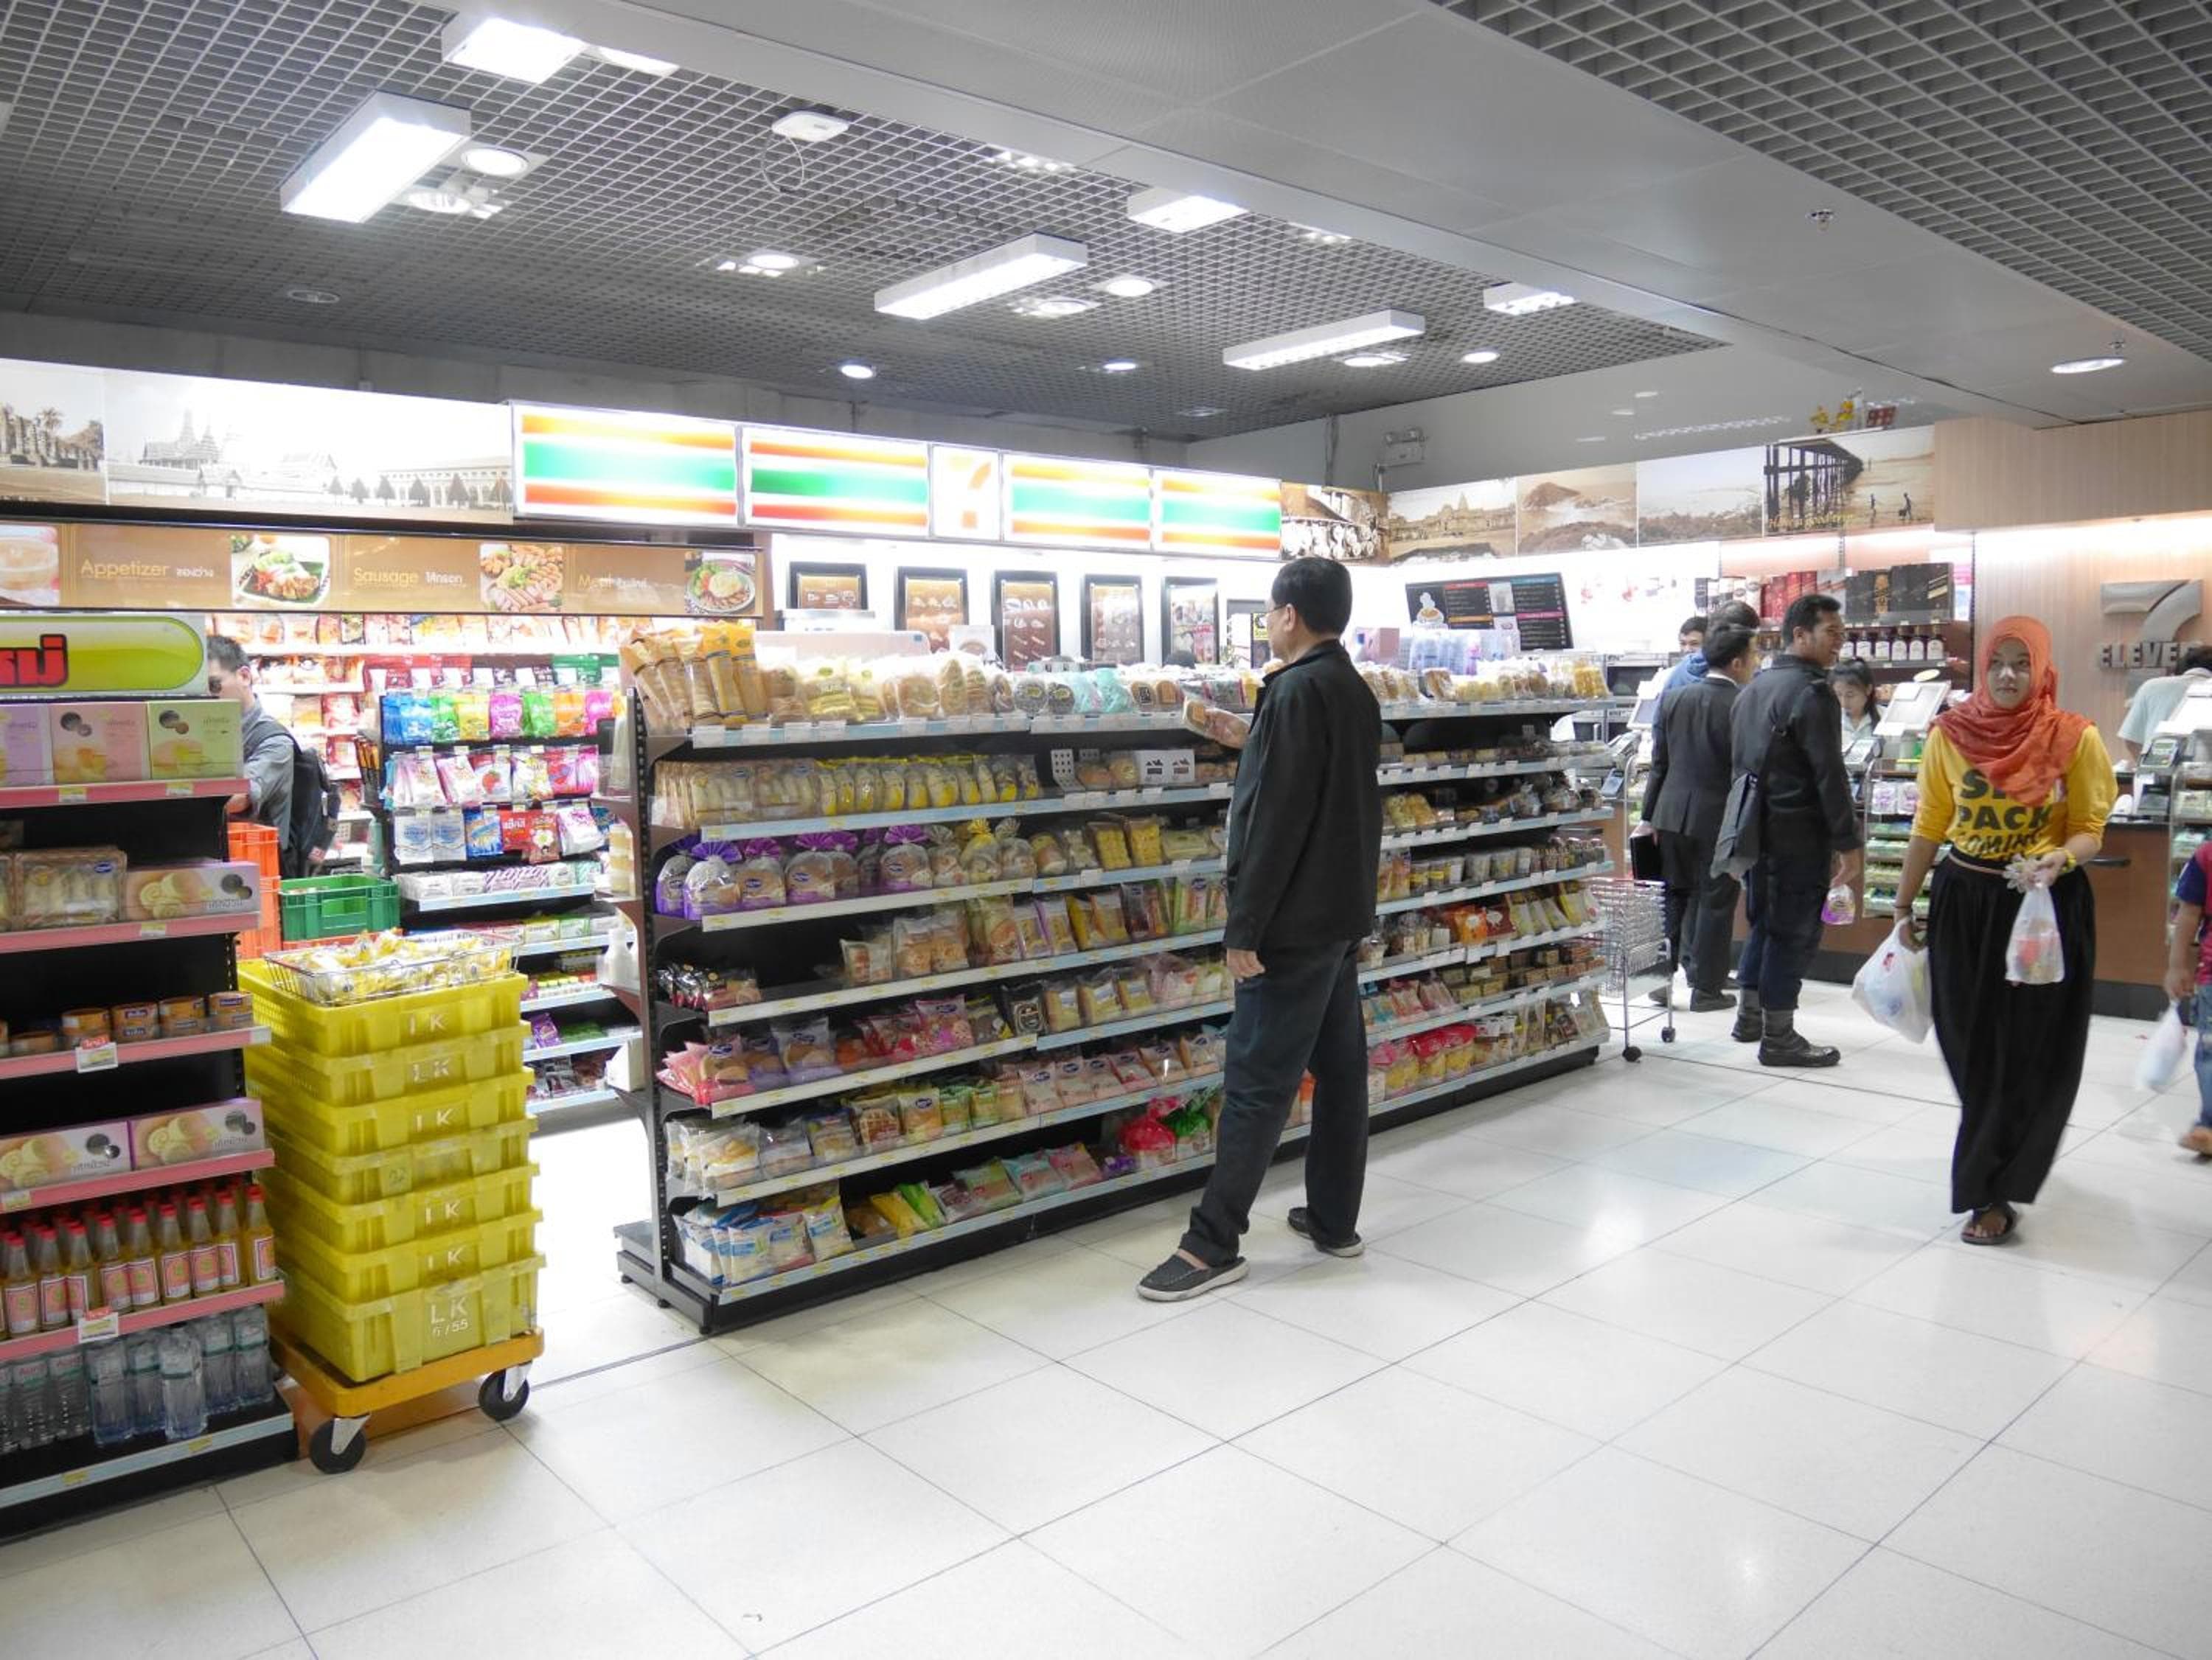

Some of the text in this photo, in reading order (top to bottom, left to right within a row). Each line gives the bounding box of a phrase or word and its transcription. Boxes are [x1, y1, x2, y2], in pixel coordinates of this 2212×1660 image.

[80, 559, 168, 579] Appetizer
[353, 567, 419, 585] Sausage
[1958, 805, 2052, 830] PACK
[431, 1297, 468, 1325] LK
